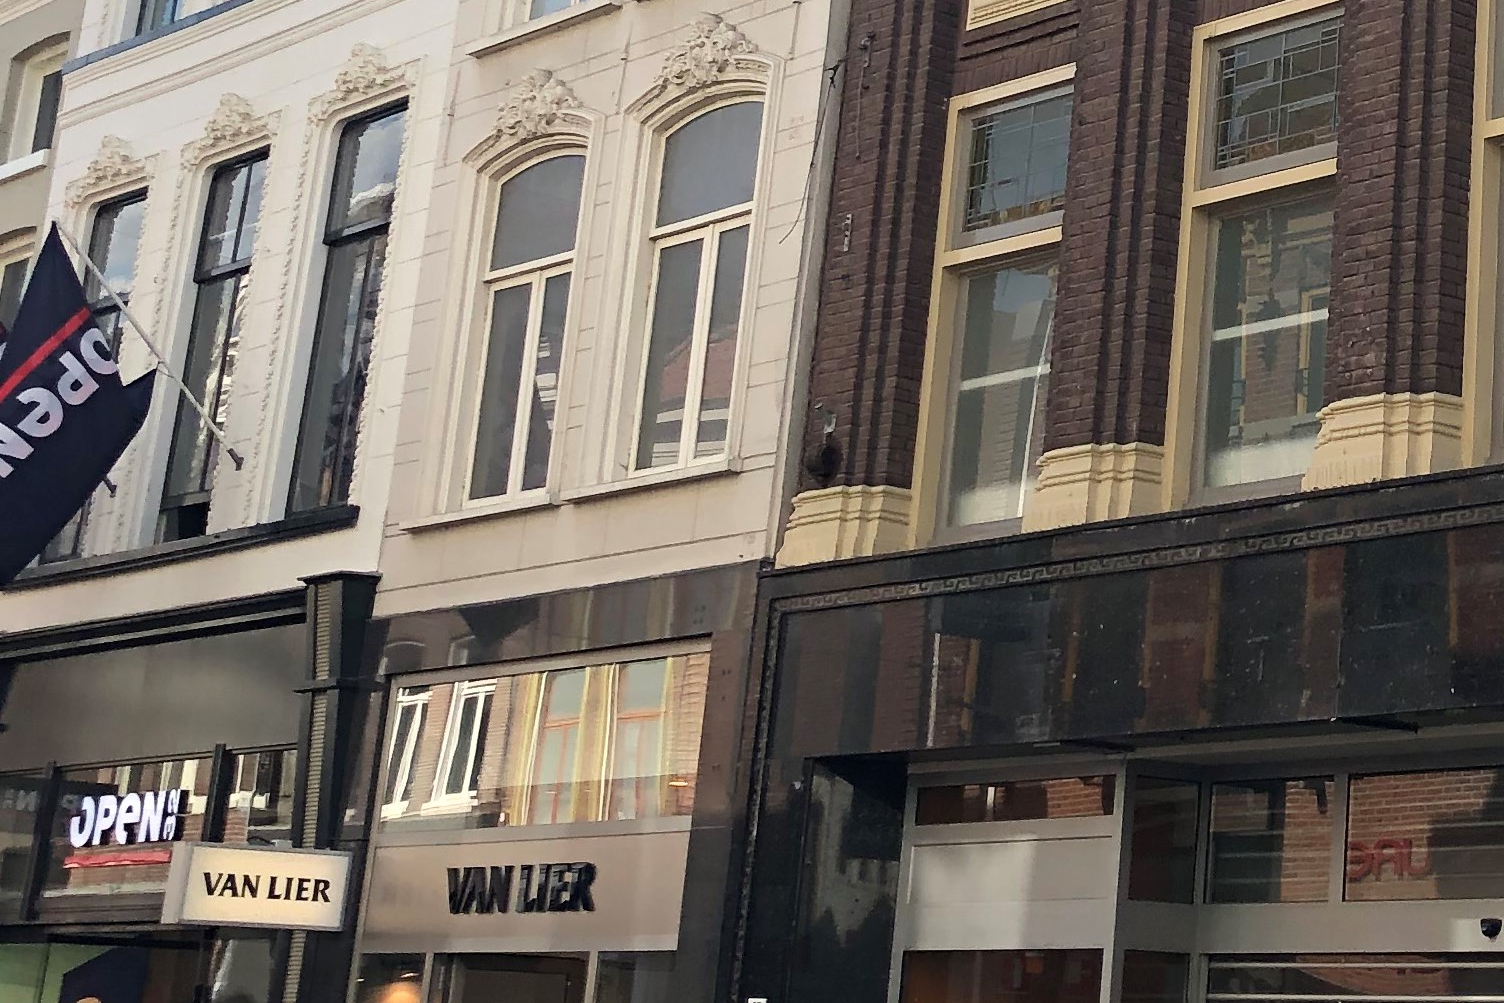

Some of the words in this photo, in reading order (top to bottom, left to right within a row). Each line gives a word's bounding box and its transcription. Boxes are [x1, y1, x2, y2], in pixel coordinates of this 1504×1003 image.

[203, 871, 262, 899] VAN
[266, 875, 331, 903] LIER
[446, 865, 516, 915] VAN
[514, 862, 597, 914] LIER
